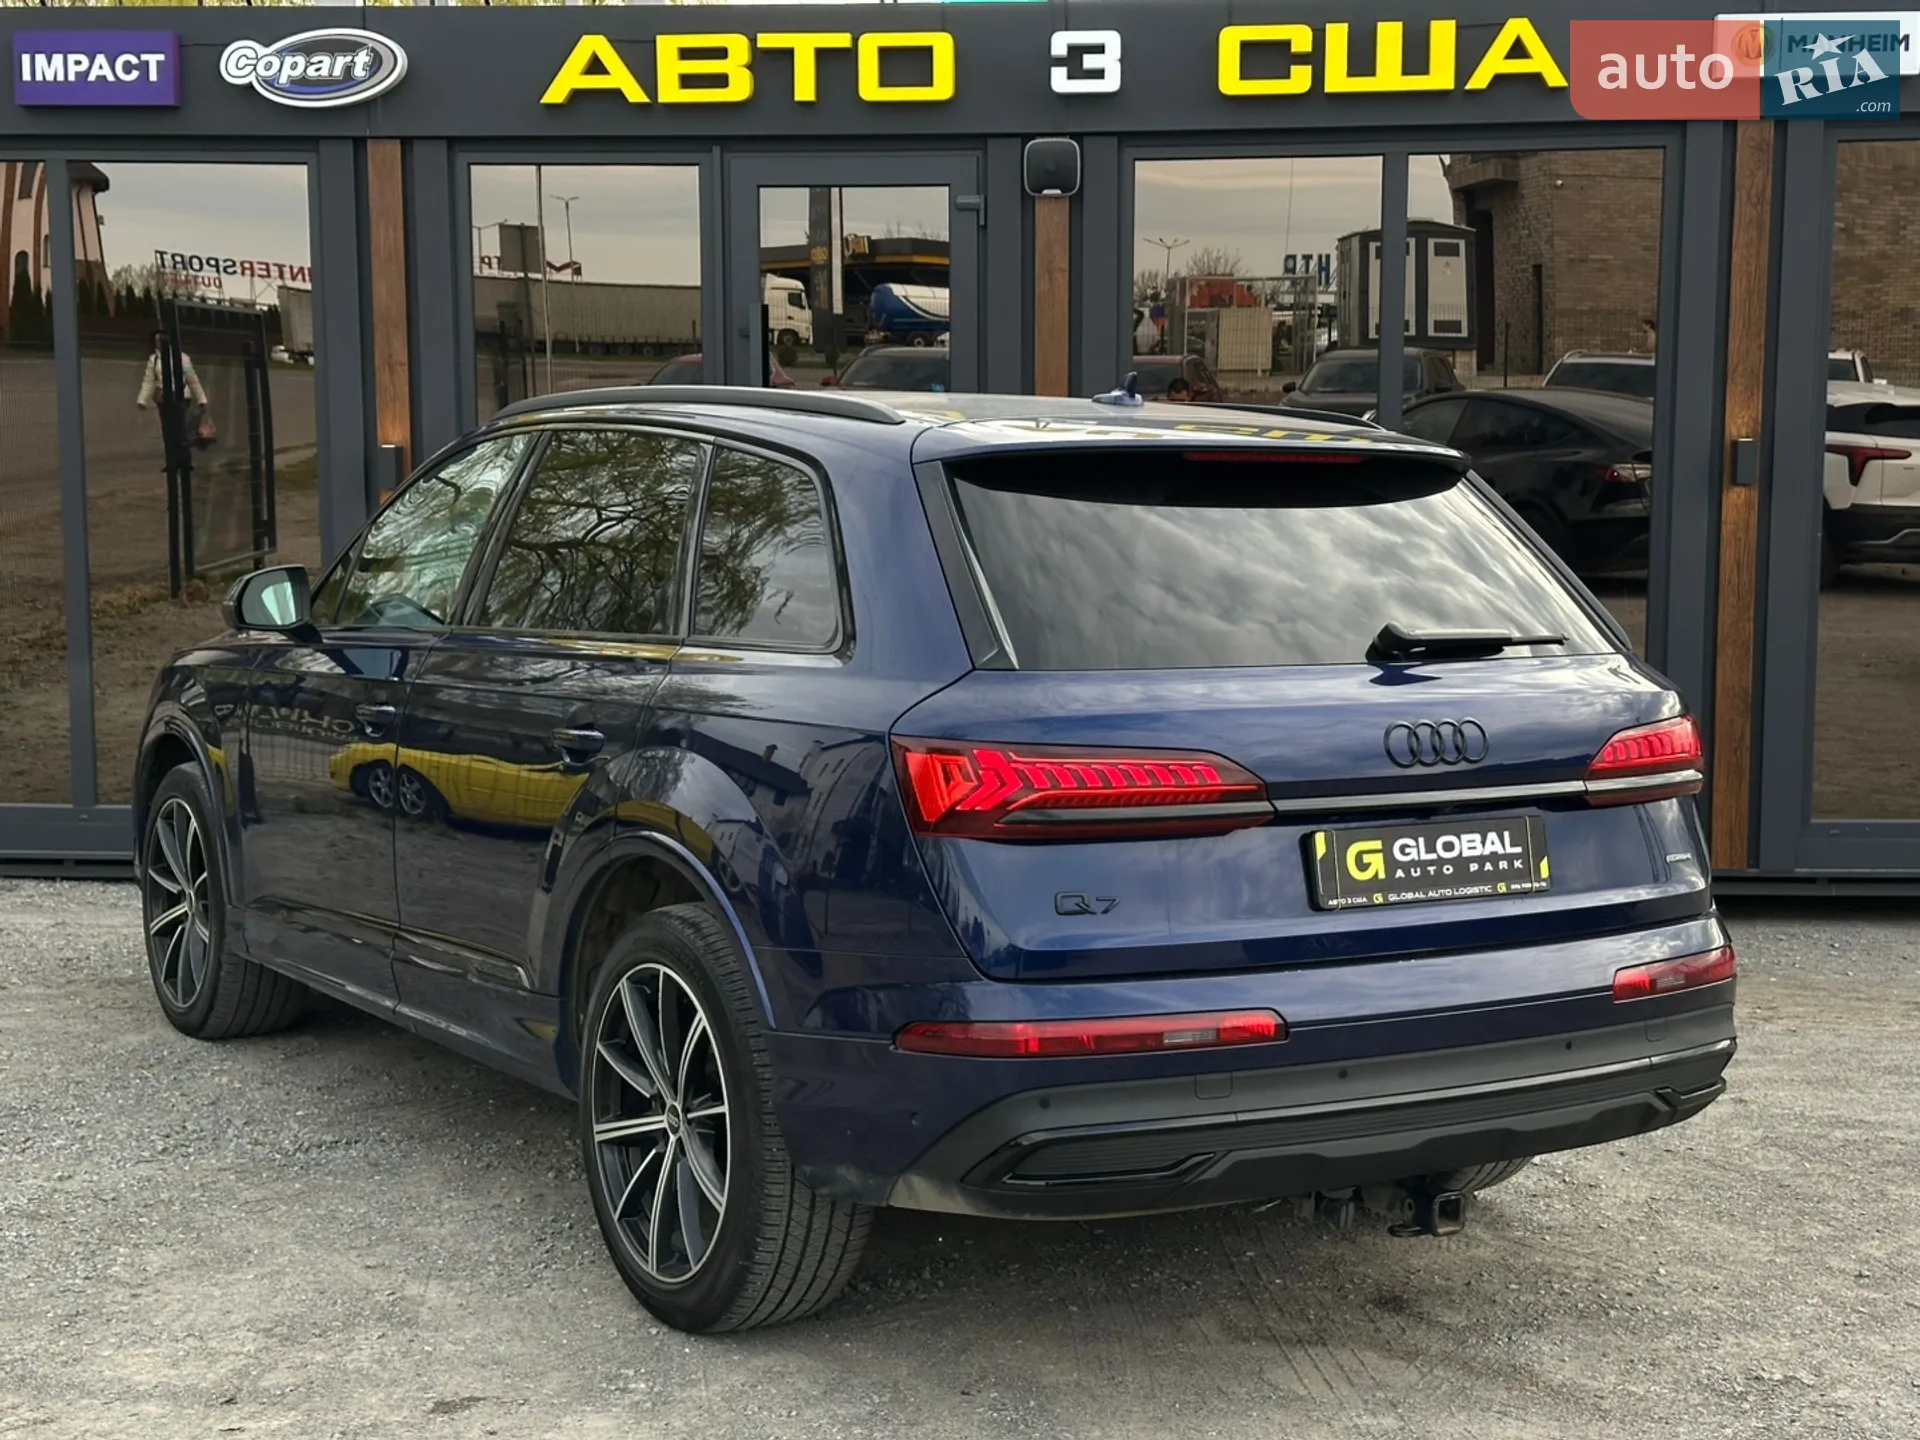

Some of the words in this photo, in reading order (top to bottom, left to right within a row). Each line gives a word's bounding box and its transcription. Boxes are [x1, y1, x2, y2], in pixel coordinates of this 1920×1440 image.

[21, 53, 165, 83] IMPACT
[226, 44, 373, 87] Copart
[540, 32, 955, 104] АВТО
[1217, 17, 1568, 96] США
[1393, 830, 1522, 862] GLOBAL
[1395, 865, 1454, 878] AUTO
[1469, 859, 1523, 872] PARK
[1054, 891, 1120, 915] Q7
[1388, 892, 1426, 901] GLOBAL
[1428, 889, 1452, 898] AUTO
[1453, 885, 1492, 895] LOGISTIC
